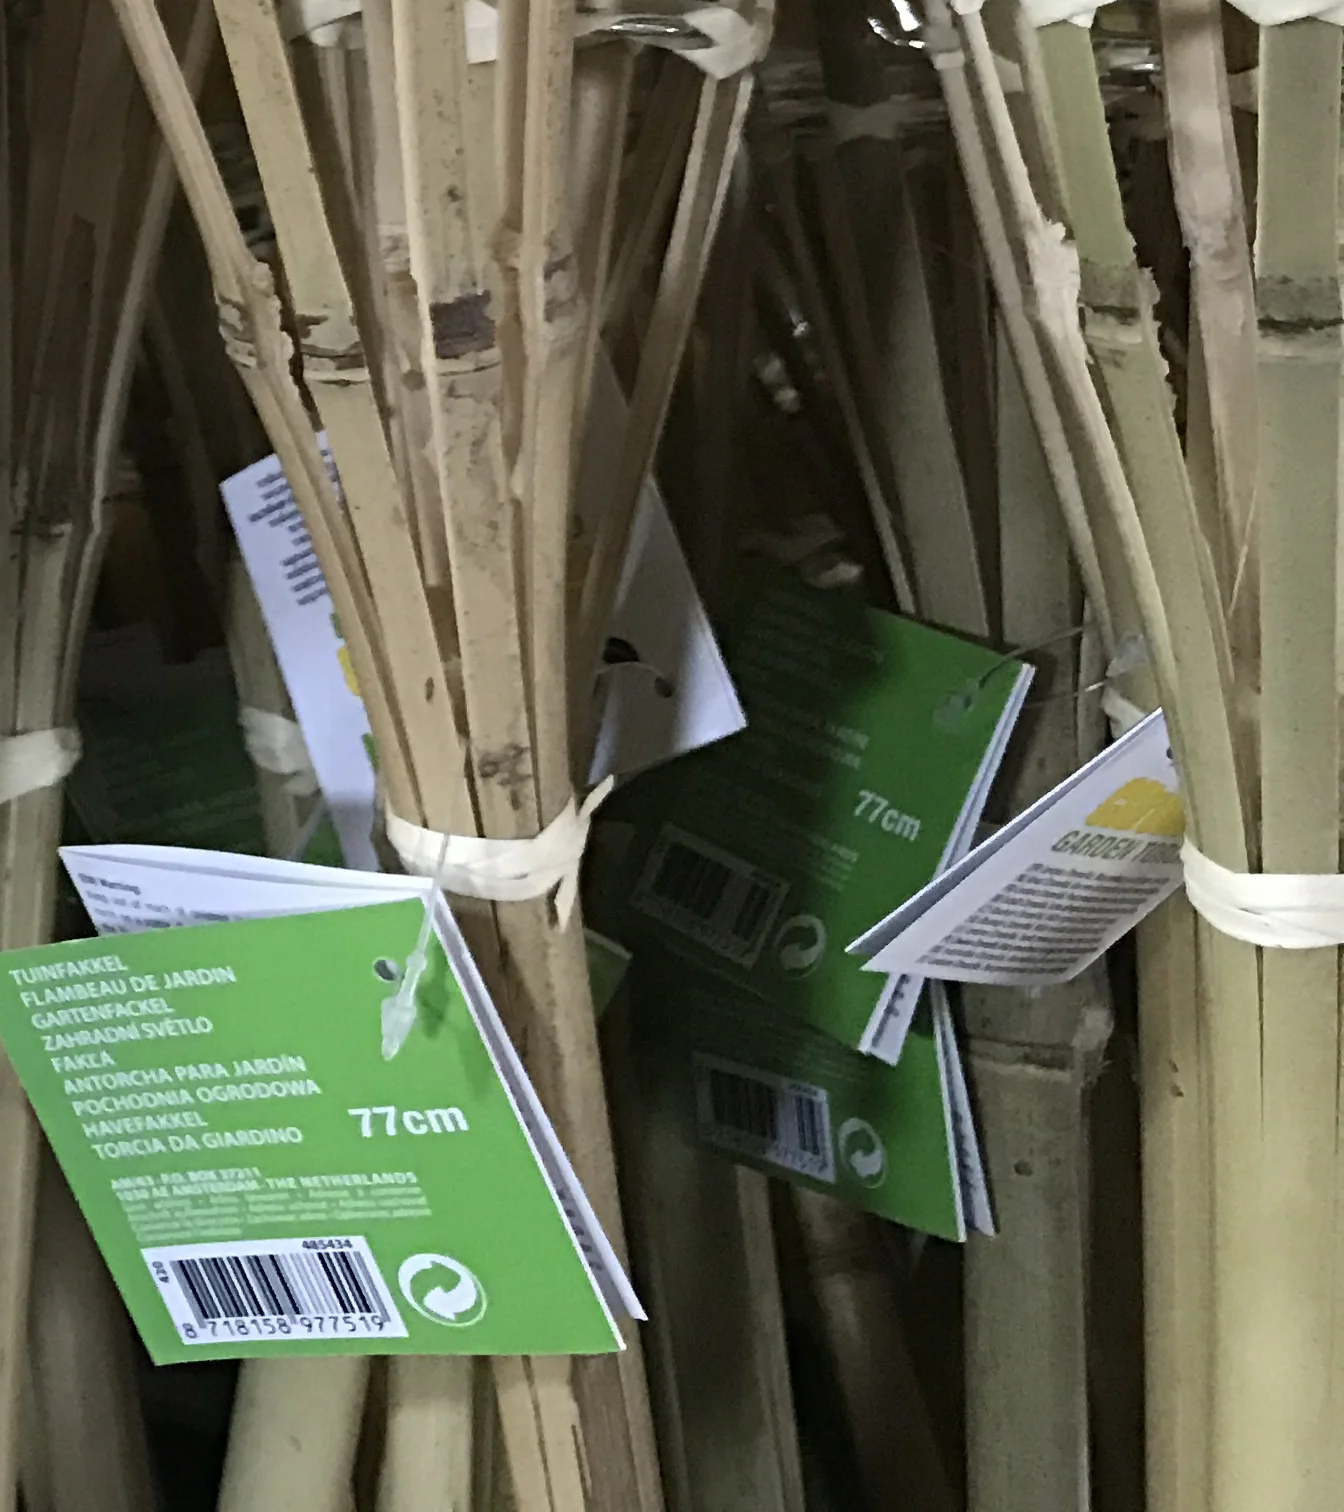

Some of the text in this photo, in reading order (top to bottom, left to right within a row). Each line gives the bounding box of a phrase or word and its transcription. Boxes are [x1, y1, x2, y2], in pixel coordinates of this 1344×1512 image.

[853, 789, 921, 841] 77cm
[1051, 829, 1138, 862] GARDEN
[9, 954, 129, 986] TUINFAKKEL
[20, 966, 237, 1008] FLAMBEAU DE JARDIN
[30, 997, 175, 1030] GARTENFACKEL
[41, 1016, 213, 1052] ZAHRADNÍ SVĚTLO
[64, 1053, 307, 1096] ANTORCHA PARA JARDÍN
[72, 1078, 323, 1117] POCHODNIA OGRODOWA
[81, 1111, 209, 1139] HAVEFAKKEL
[347, 1105, 470, 1138] 77cm
[92, 1126, 304, 1160] TORCIA DA GIARDINO
[300, 1171, 418, 1189] NETHERLANDS
[184, 1315, 386, 1339] 8 718158 977519
